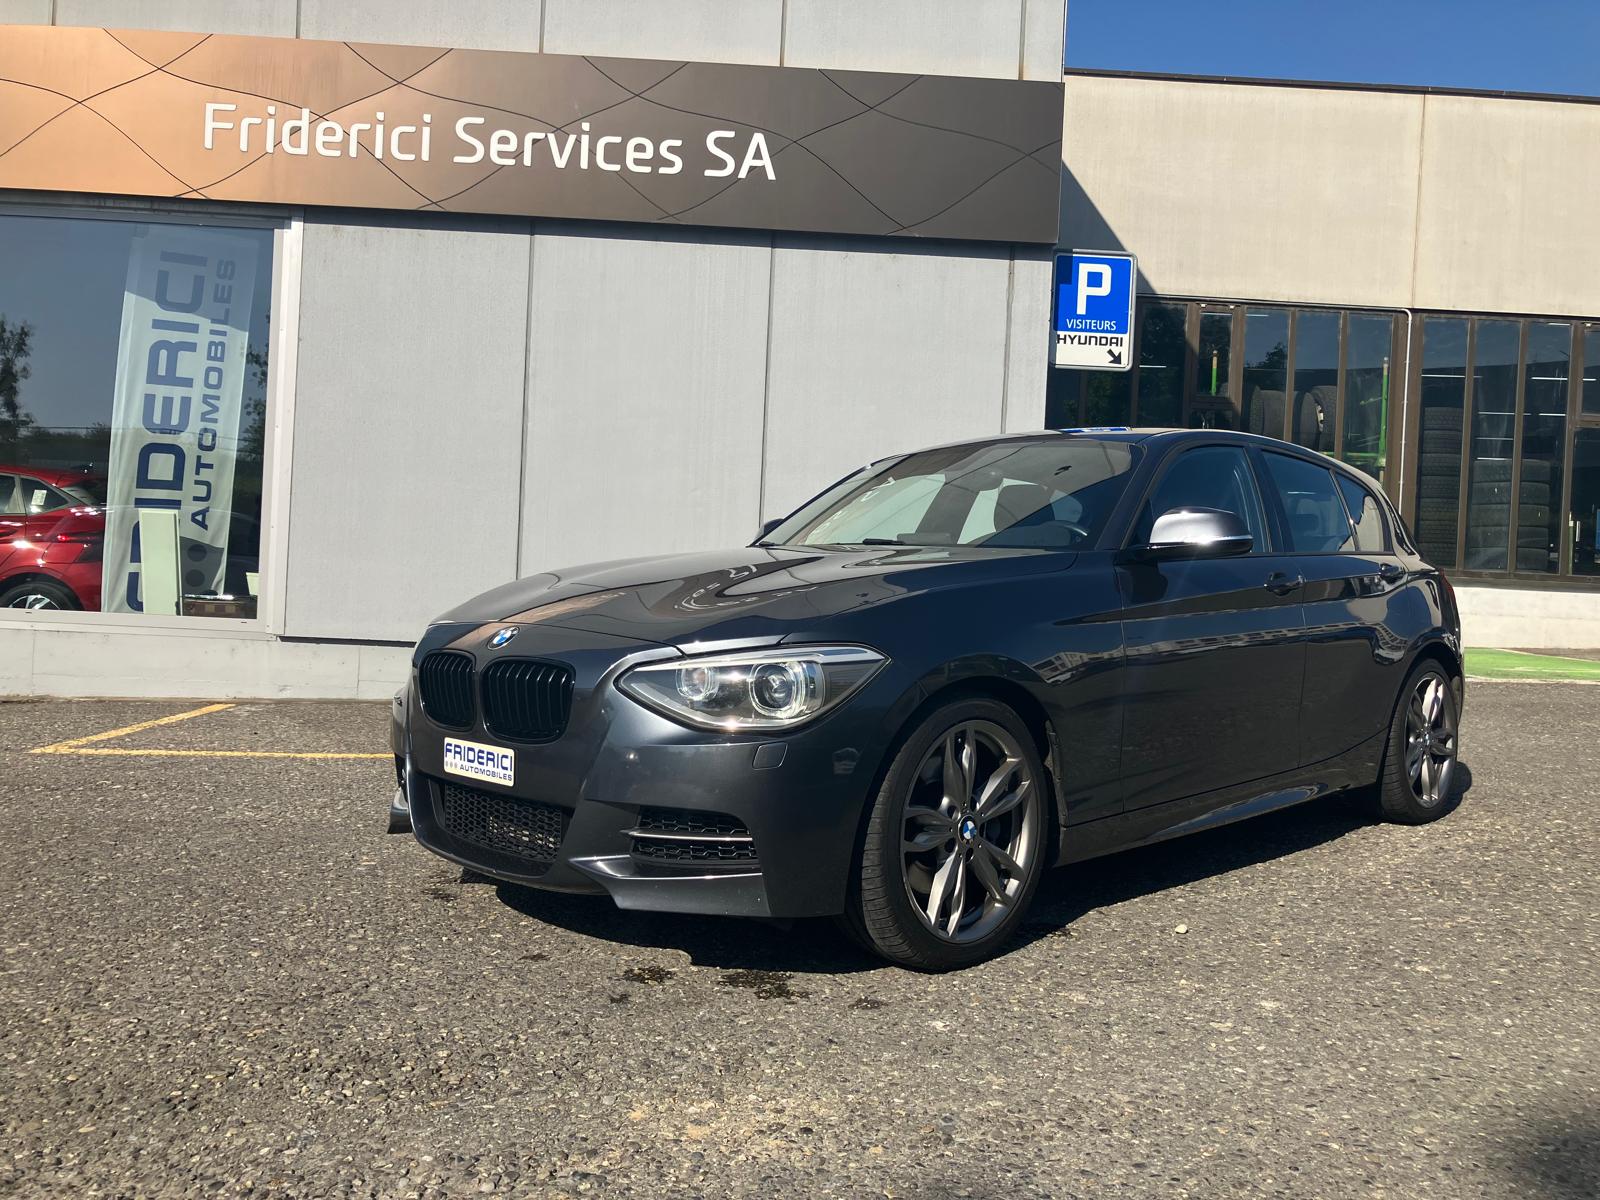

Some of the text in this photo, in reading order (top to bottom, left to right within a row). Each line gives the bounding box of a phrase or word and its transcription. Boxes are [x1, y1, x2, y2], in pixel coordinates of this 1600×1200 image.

[204, 102, 777, 181] Friderici Services SA
[1076, 262, 1112, 315] P
[1057, 333, 1124, 347] HYUNDAI
[1066, 318, 1117, 331] VISITEURS
[190, 259, 236, 531] AUTOMOBILES
[126, 251, 208, 612] IDERICI
[445, 742, 513, 772] FRIDERICI
[460, 763, 513, 782] AUTOMOBILES
